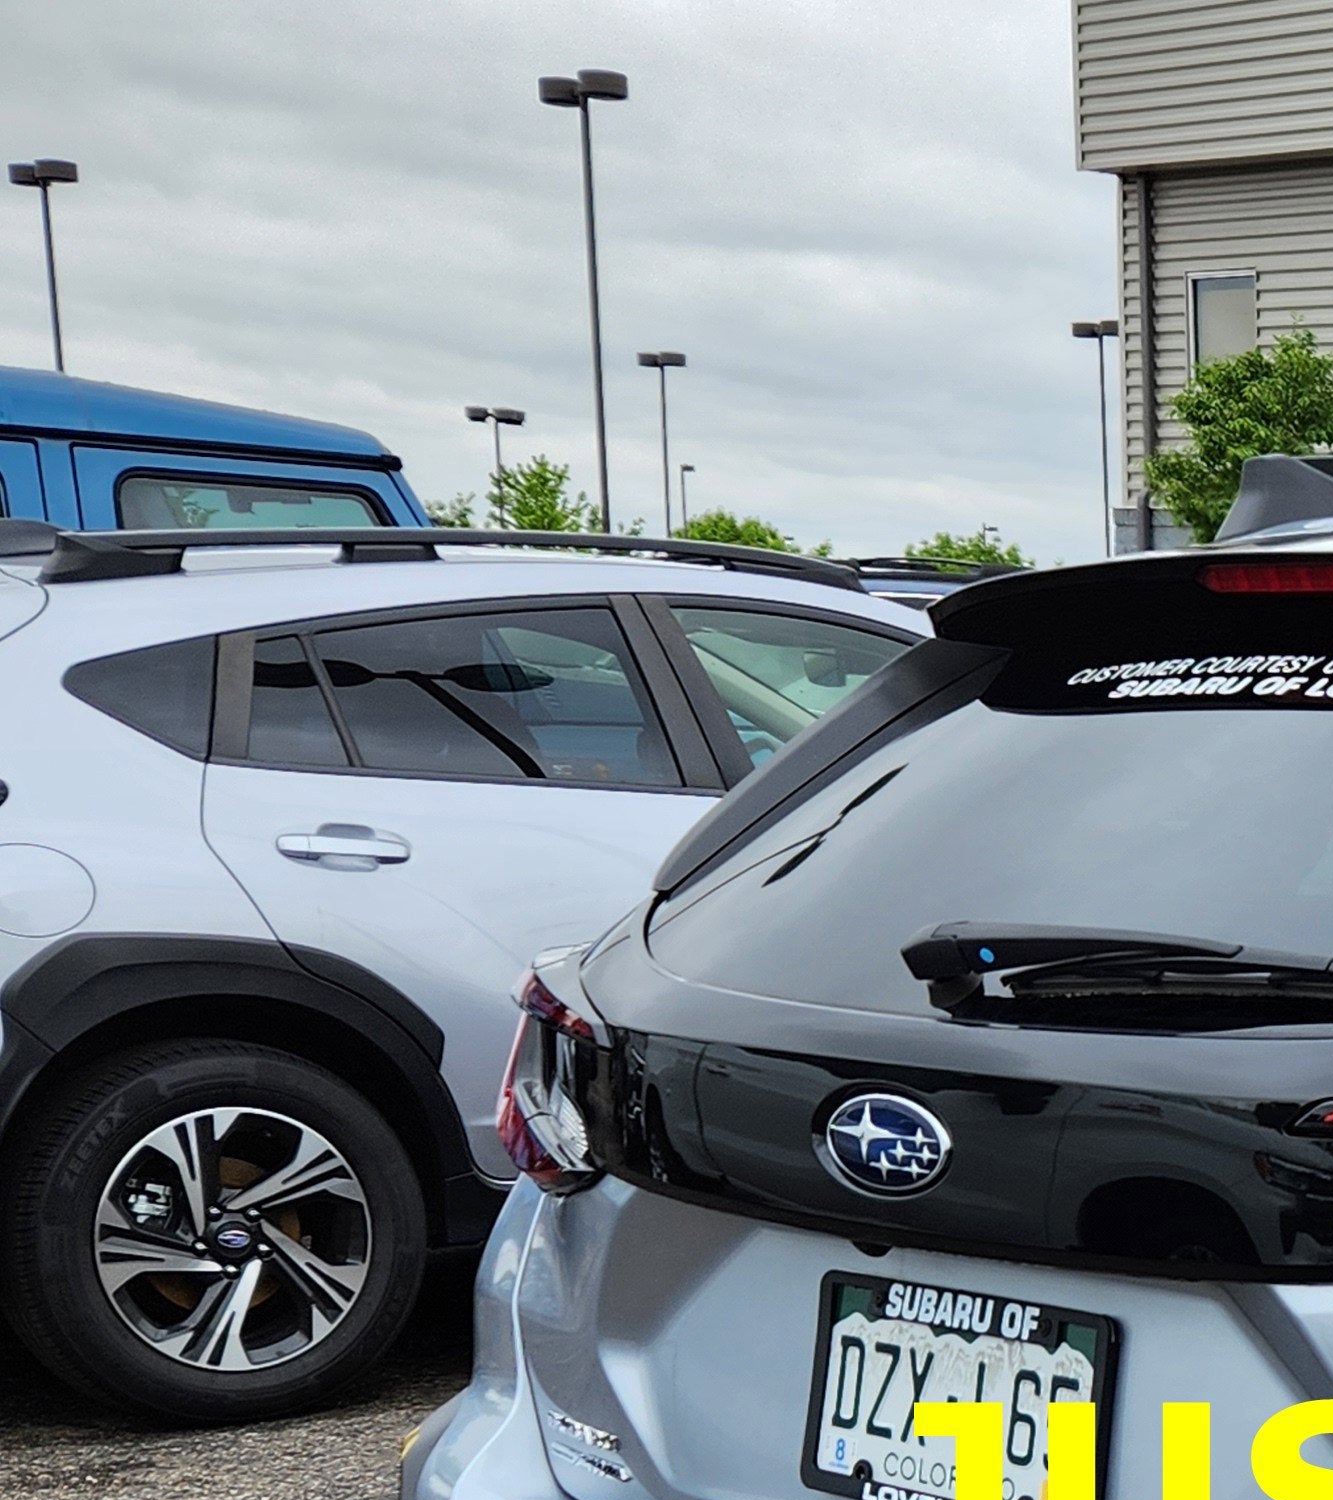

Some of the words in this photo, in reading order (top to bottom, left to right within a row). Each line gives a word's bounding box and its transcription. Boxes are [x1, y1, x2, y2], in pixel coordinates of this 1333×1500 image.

[1066, 658, 1195, 685] CUSTOMER
[1191, 655, 1326, 675] COURTESY
[1107, 676, 1254, 699] SUBARU
[1252, 676, 1310, 697] OF
[885, 1282, 995, 1334] SUBARU
[1000, 1302, 1041, 1341] OF
[835, 1437, 846, 1461] 8
